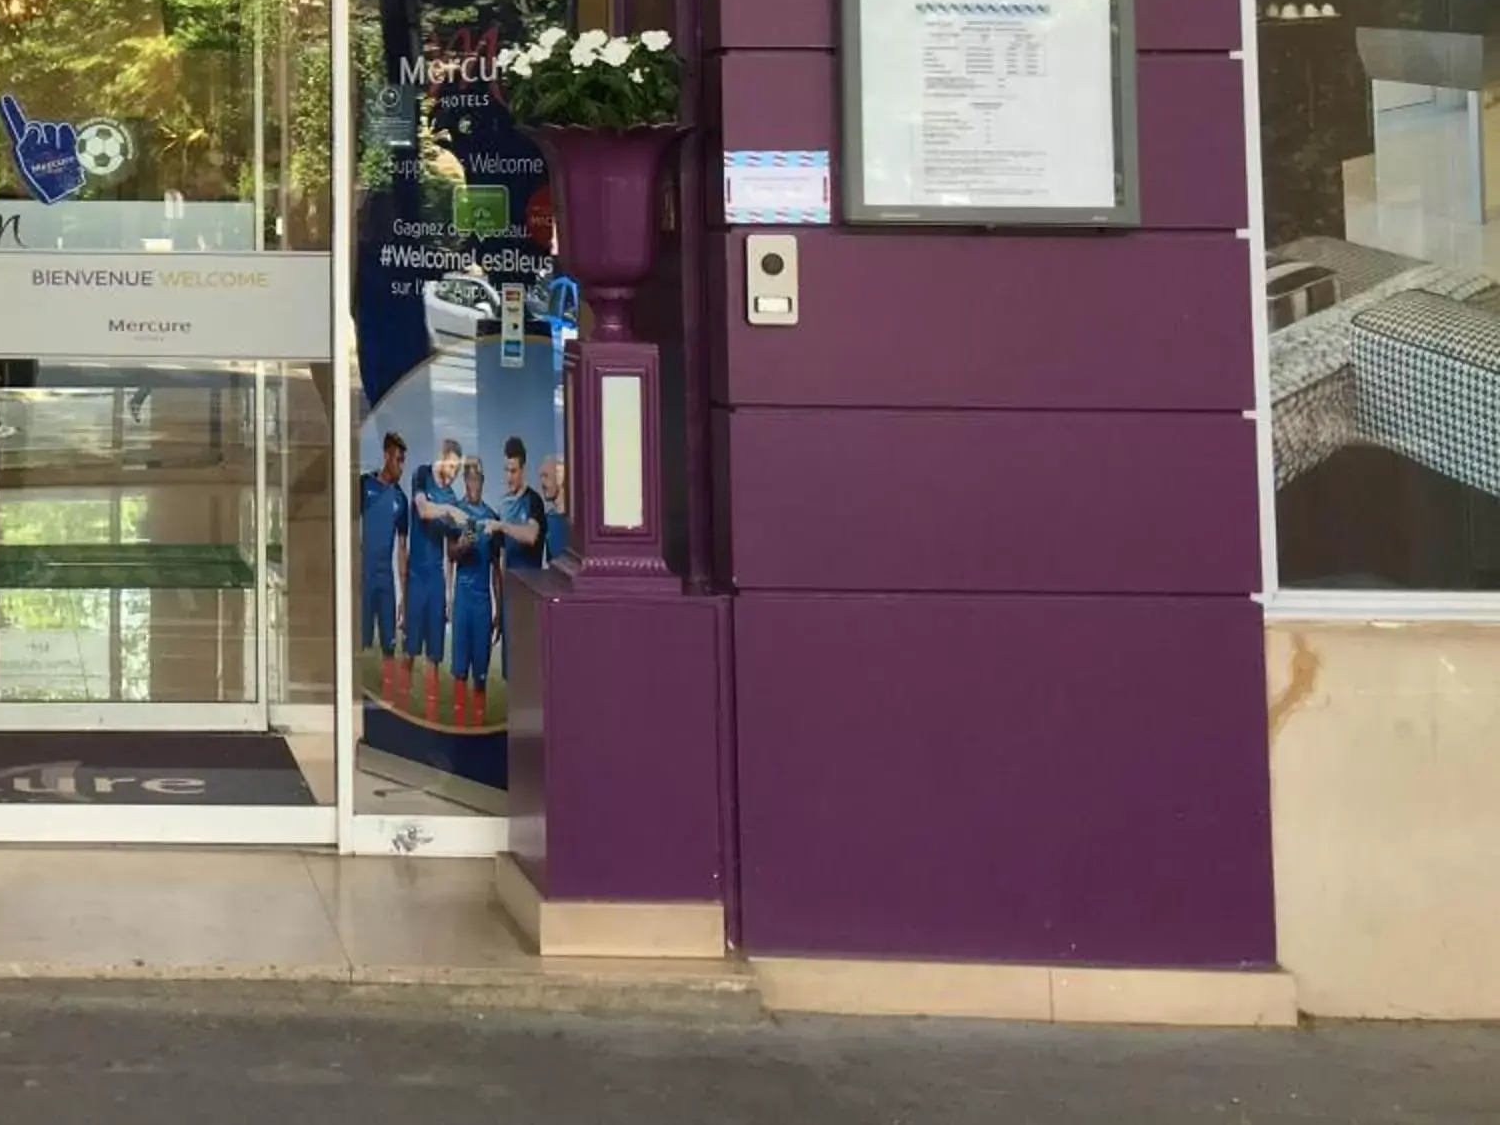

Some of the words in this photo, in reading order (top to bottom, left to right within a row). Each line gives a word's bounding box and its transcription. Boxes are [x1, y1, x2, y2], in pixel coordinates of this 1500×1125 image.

[441, 93, 490, 108] HOTELS
[470, 152, 544, 174] Welcome
[393, 218, 443, 240] Gagnez
[31, 269, 154, 287] BIENVENUE
[158, 271, 269, 288] WELCOME
[108, 318, 193, 333] Mercure
